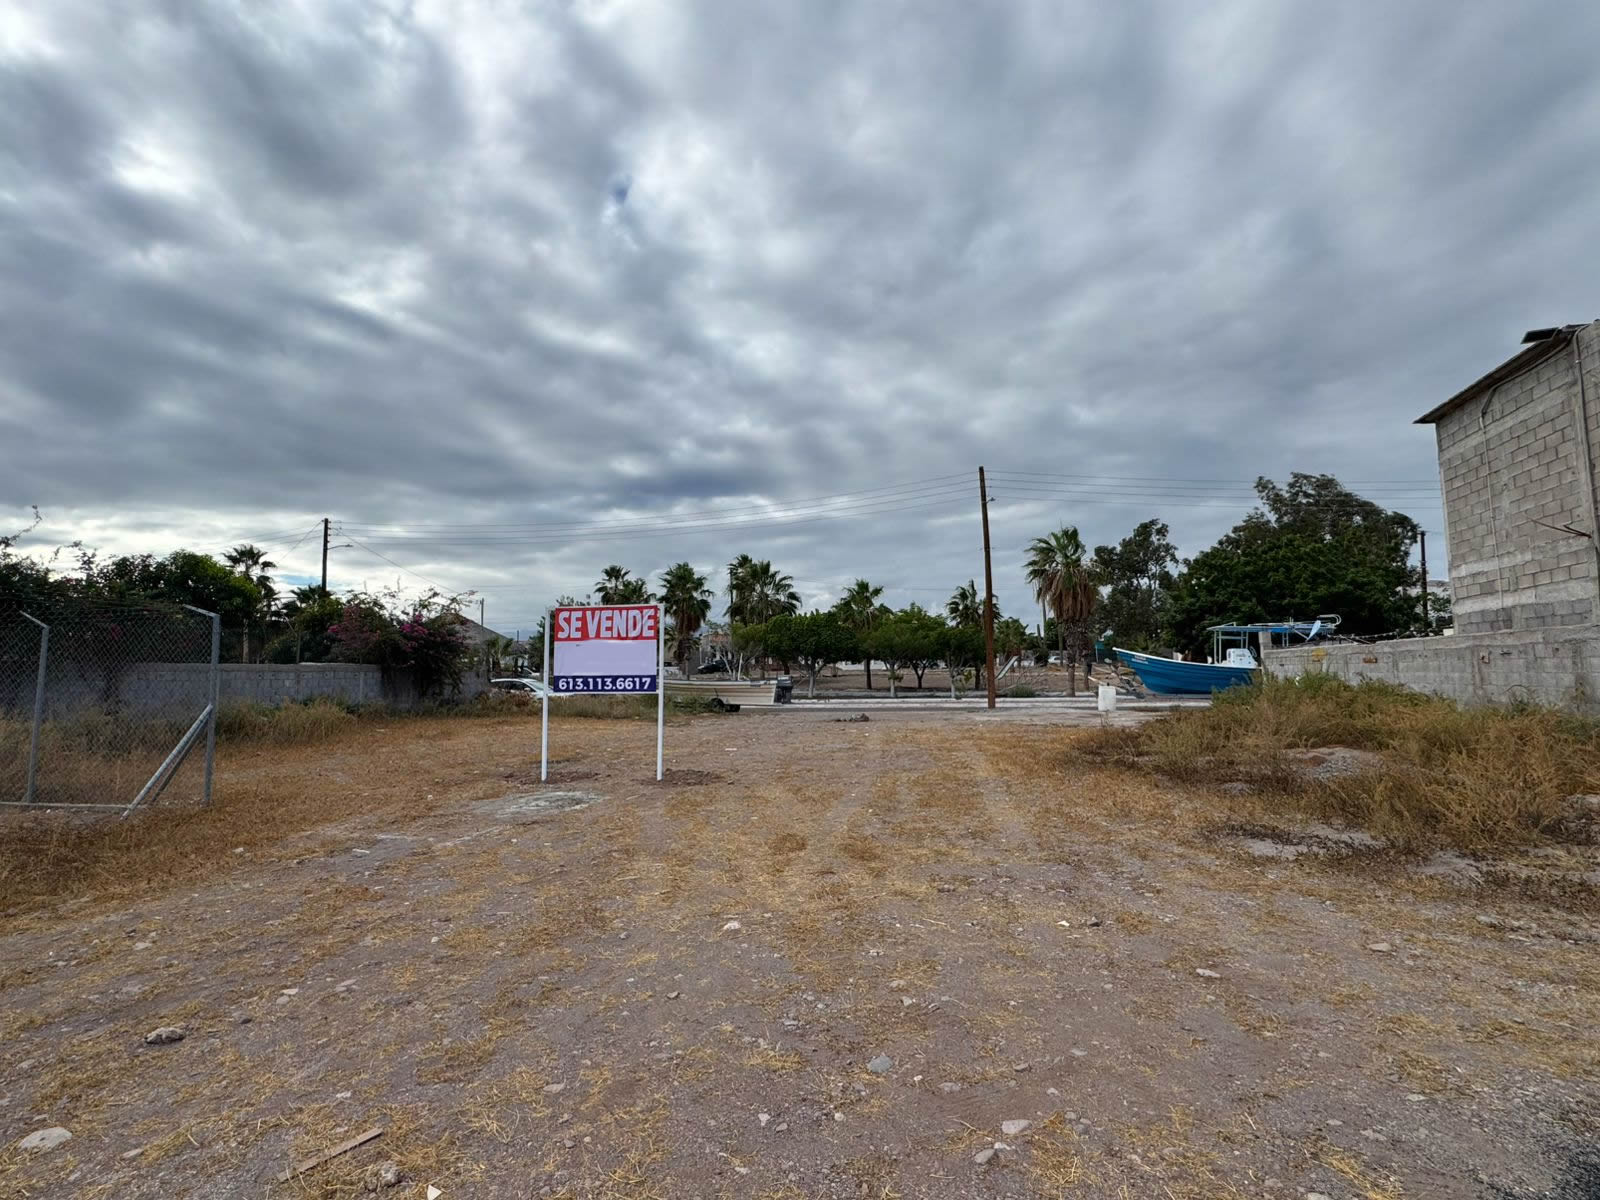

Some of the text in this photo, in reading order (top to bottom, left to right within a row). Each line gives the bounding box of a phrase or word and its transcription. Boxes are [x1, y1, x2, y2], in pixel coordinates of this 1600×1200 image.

[557, 608, 655, 639] SE VENDE
[558, 677, 651, 690] 613.113.6617
